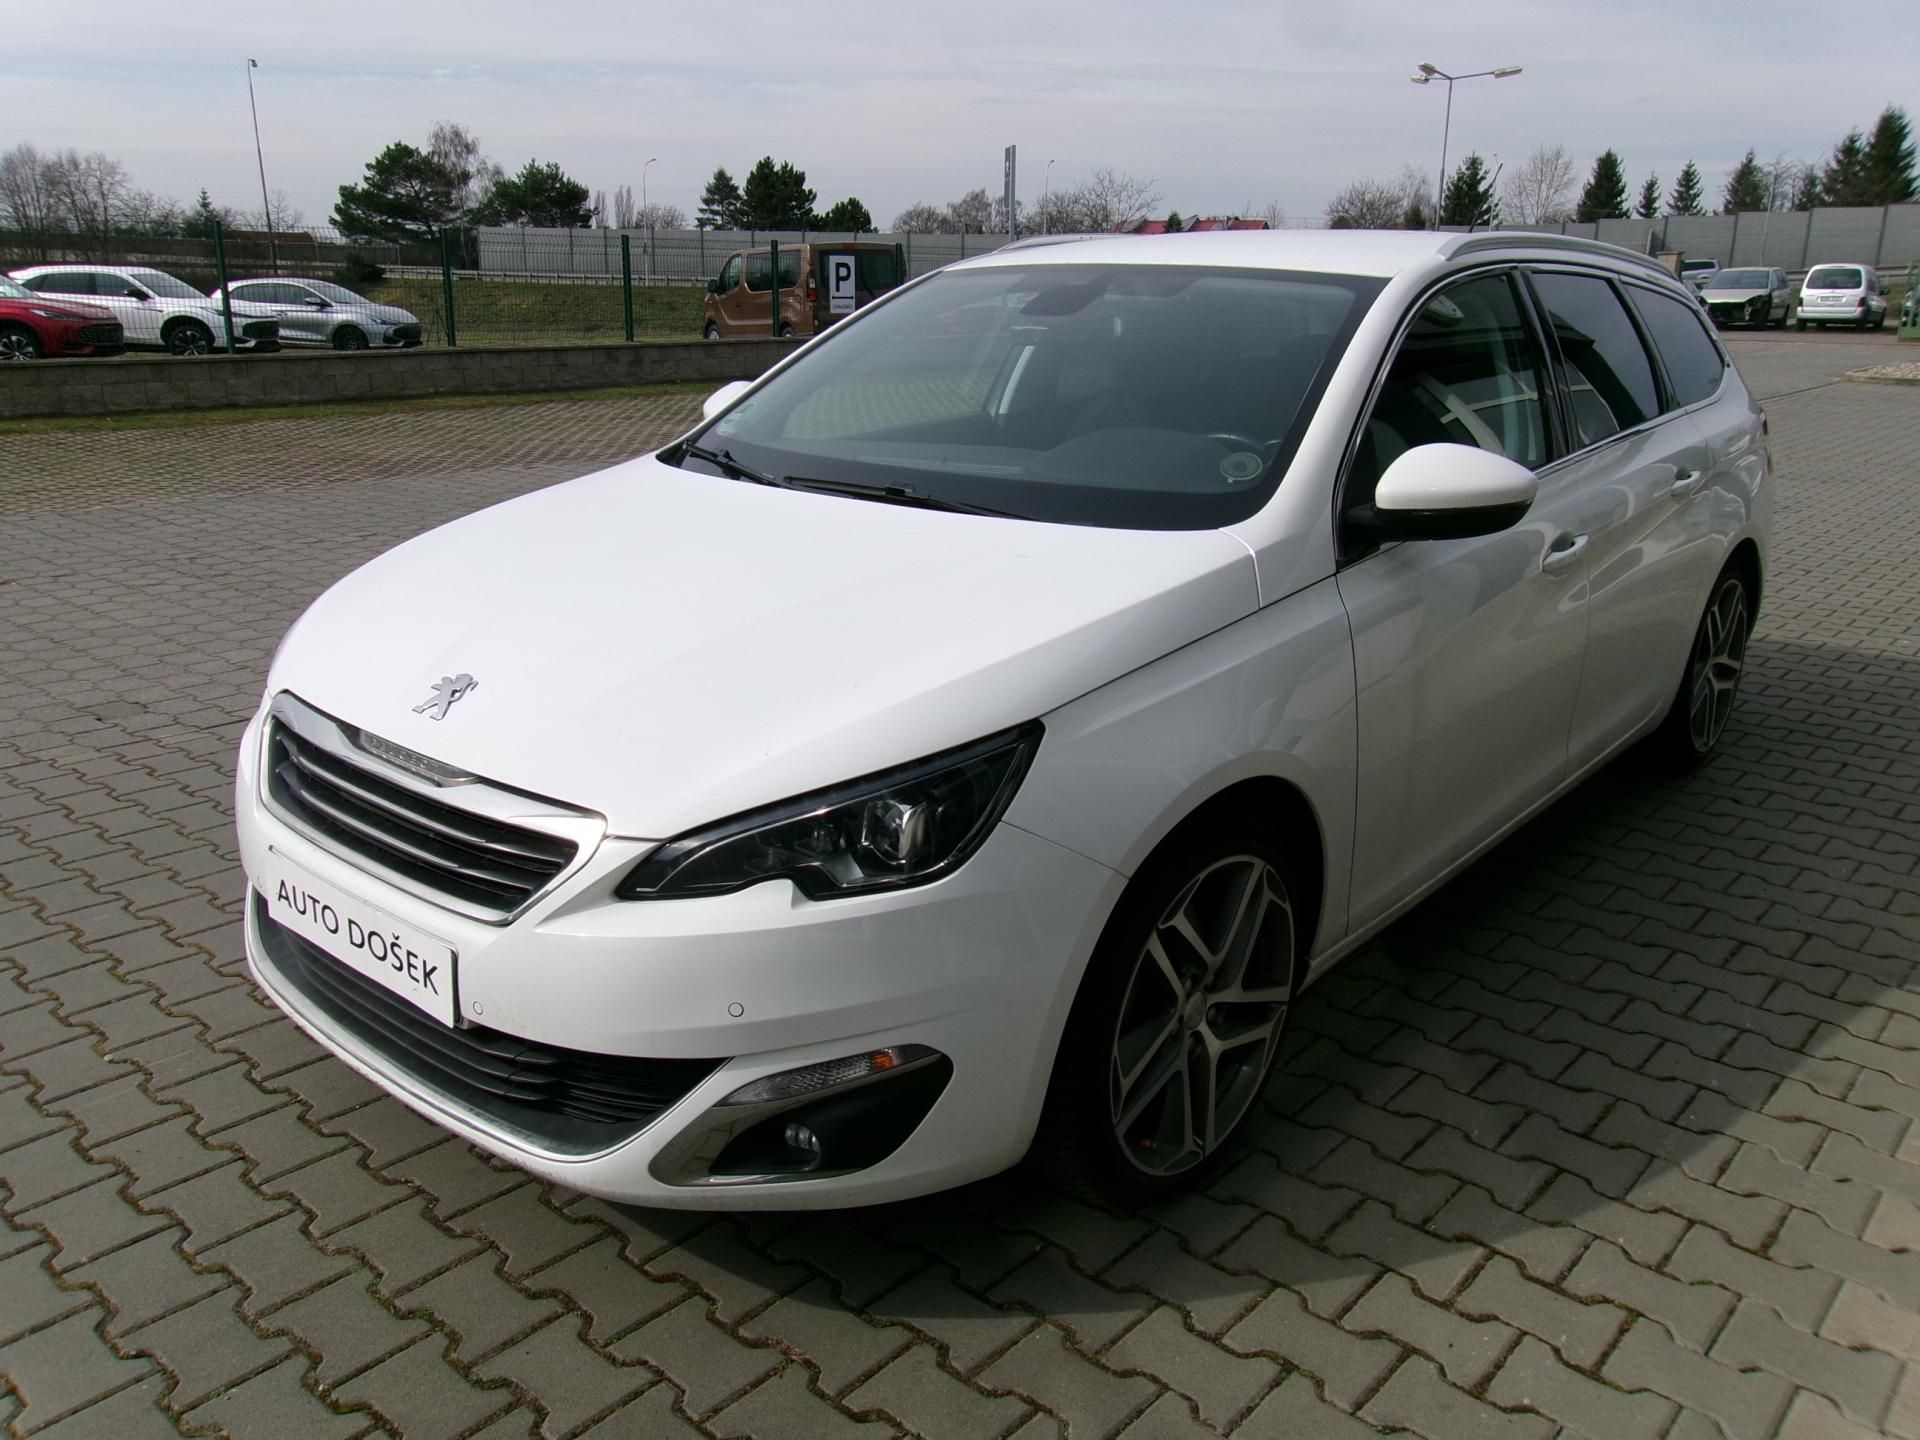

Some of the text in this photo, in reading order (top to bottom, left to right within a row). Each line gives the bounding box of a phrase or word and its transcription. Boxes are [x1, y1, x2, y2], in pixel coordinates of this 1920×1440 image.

[836, 262, 851, 292] P
[277, 879, 439, 997] AUTO DOŠEK
